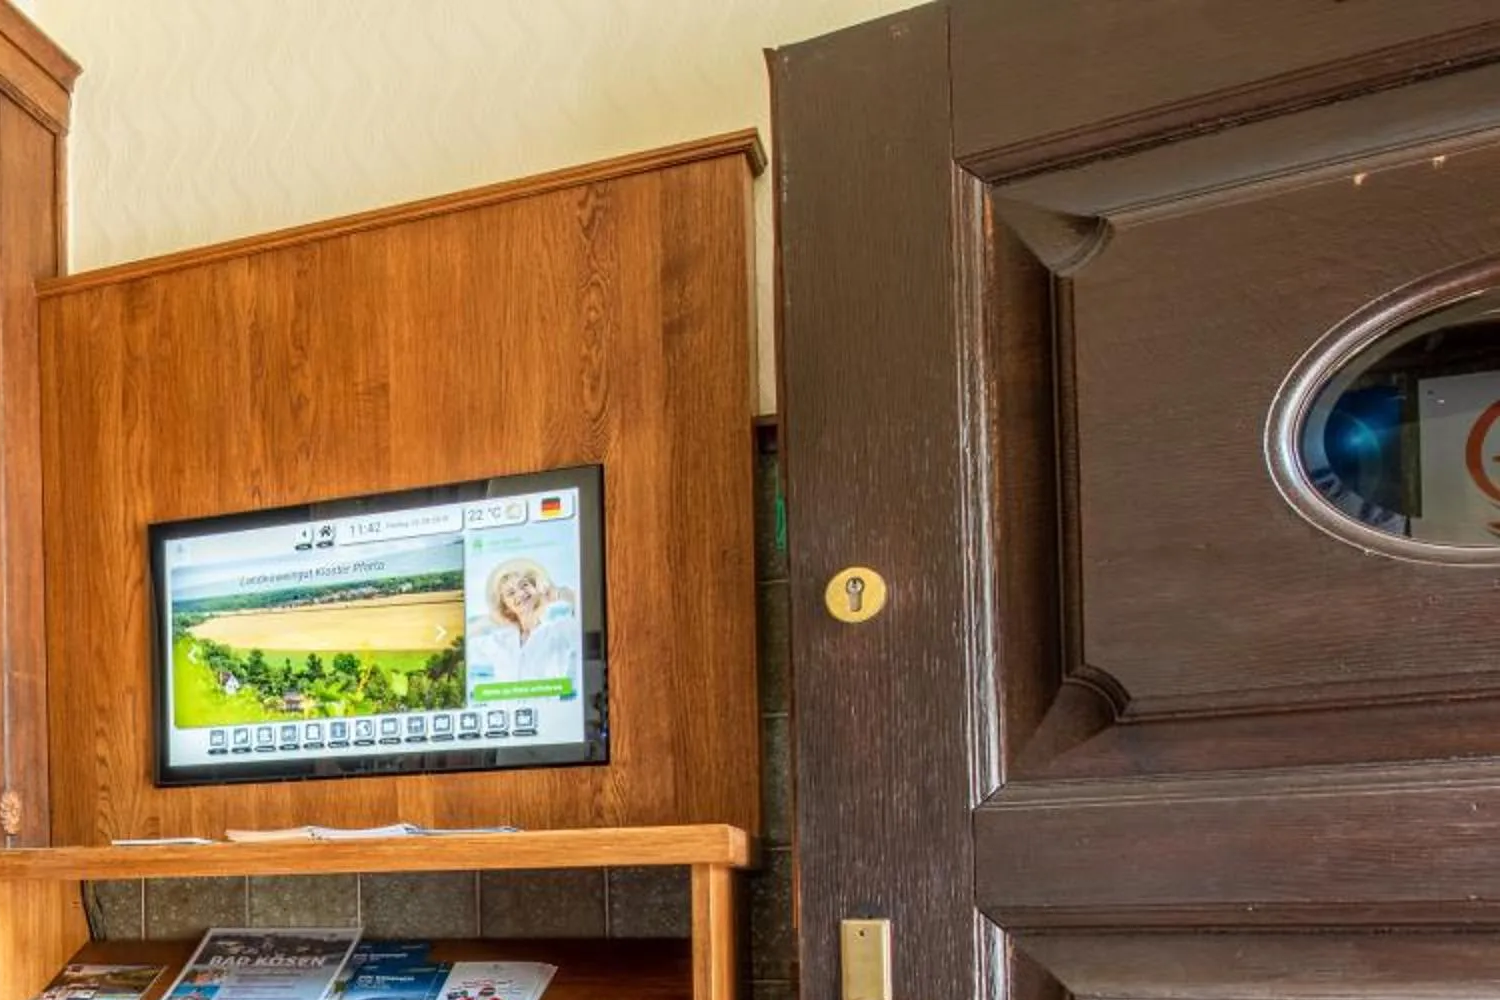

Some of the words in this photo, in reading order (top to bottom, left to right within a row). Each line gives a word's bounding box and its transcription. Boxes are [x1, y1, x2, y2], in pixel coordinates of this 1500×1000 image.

[467, 509, 484, 521] 22
[209, 954, 250, 967] BAD
[255, 951, 326, 968] KÖSEN
